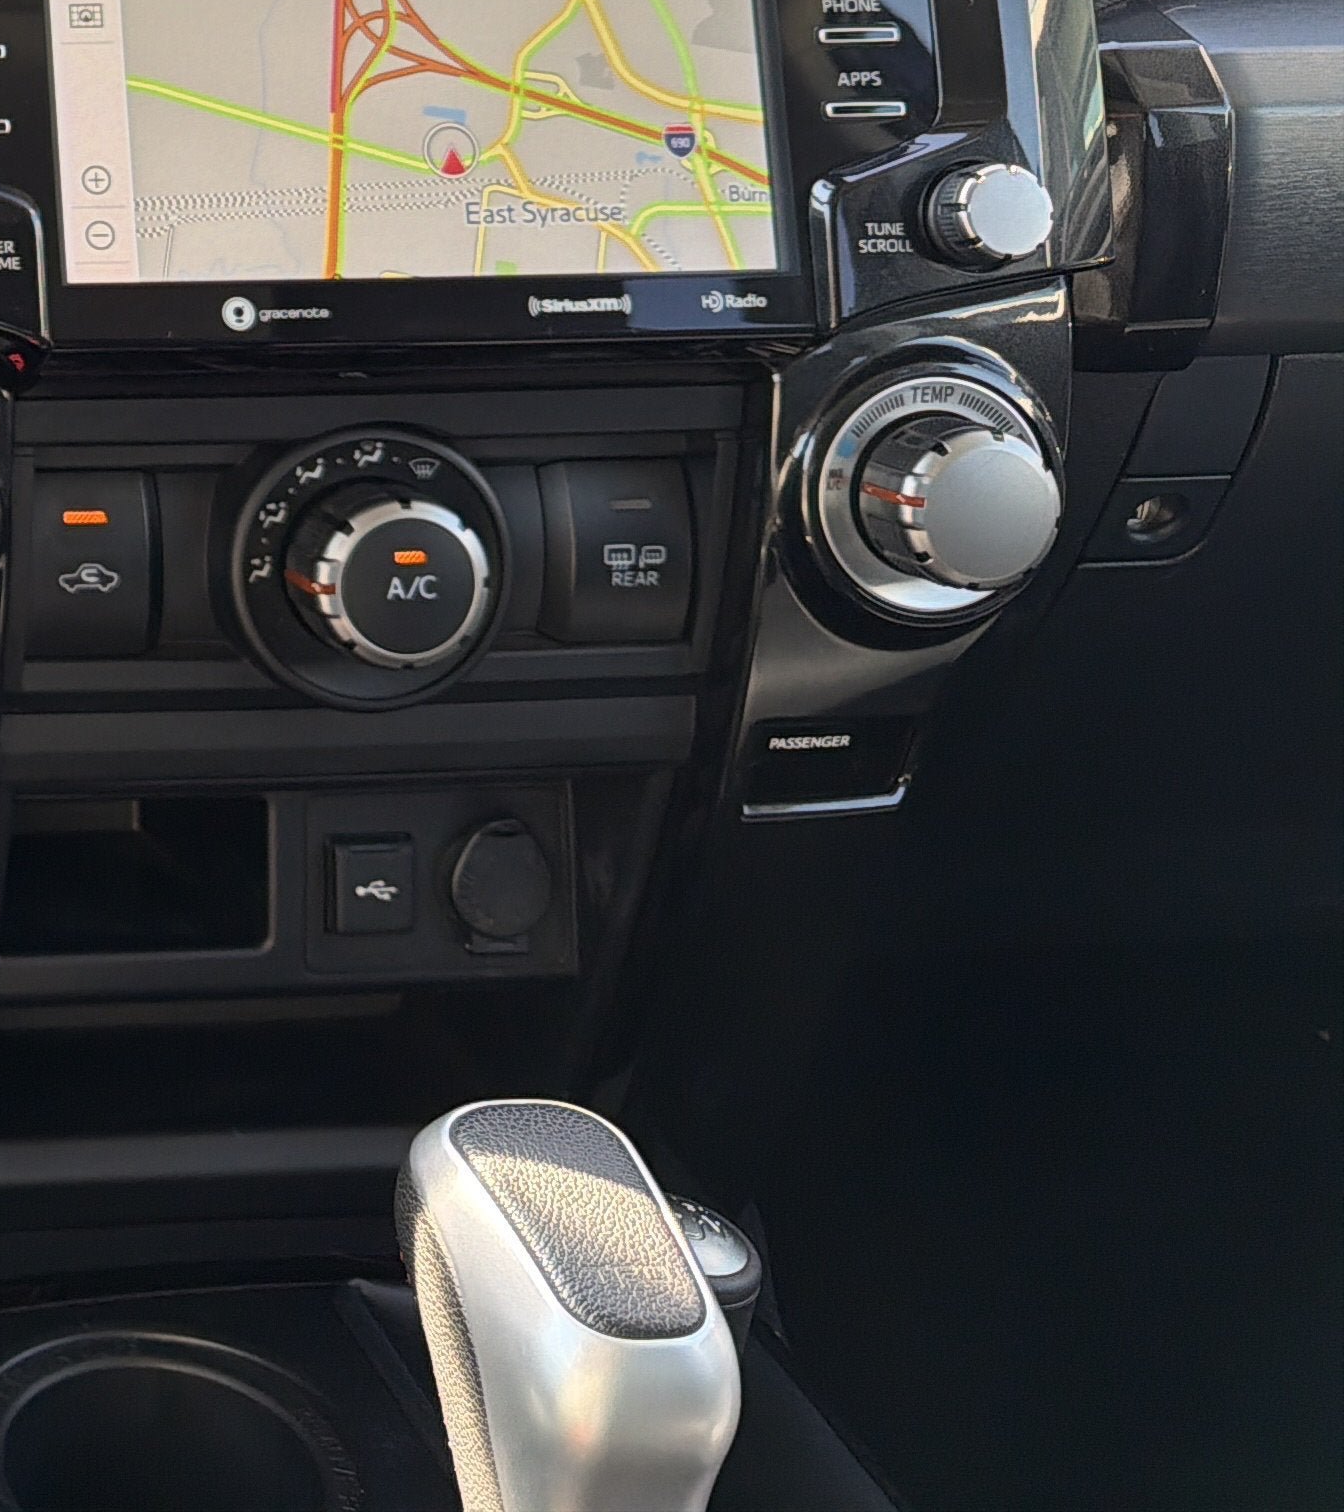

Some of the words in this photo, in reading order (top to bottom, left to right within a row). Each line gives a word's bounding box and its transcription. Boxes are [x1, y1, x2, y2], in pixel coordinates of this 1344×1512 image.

[837, 71, 882, 86] APPS
[465, 201, 515, 225] East
[864, 222, 905, 238] TUNE
[858, 238, 914, 255] SCROLL
[725, 292, 768, 308] Radio
[258, 306, 331, 321] gracenote
[911, 385, 955, 404] TEMP
[612, 571, 659, 586] REAR
[387, 576, 438, 600] A/C
[768, 735, 851, 750] PASSENGER
